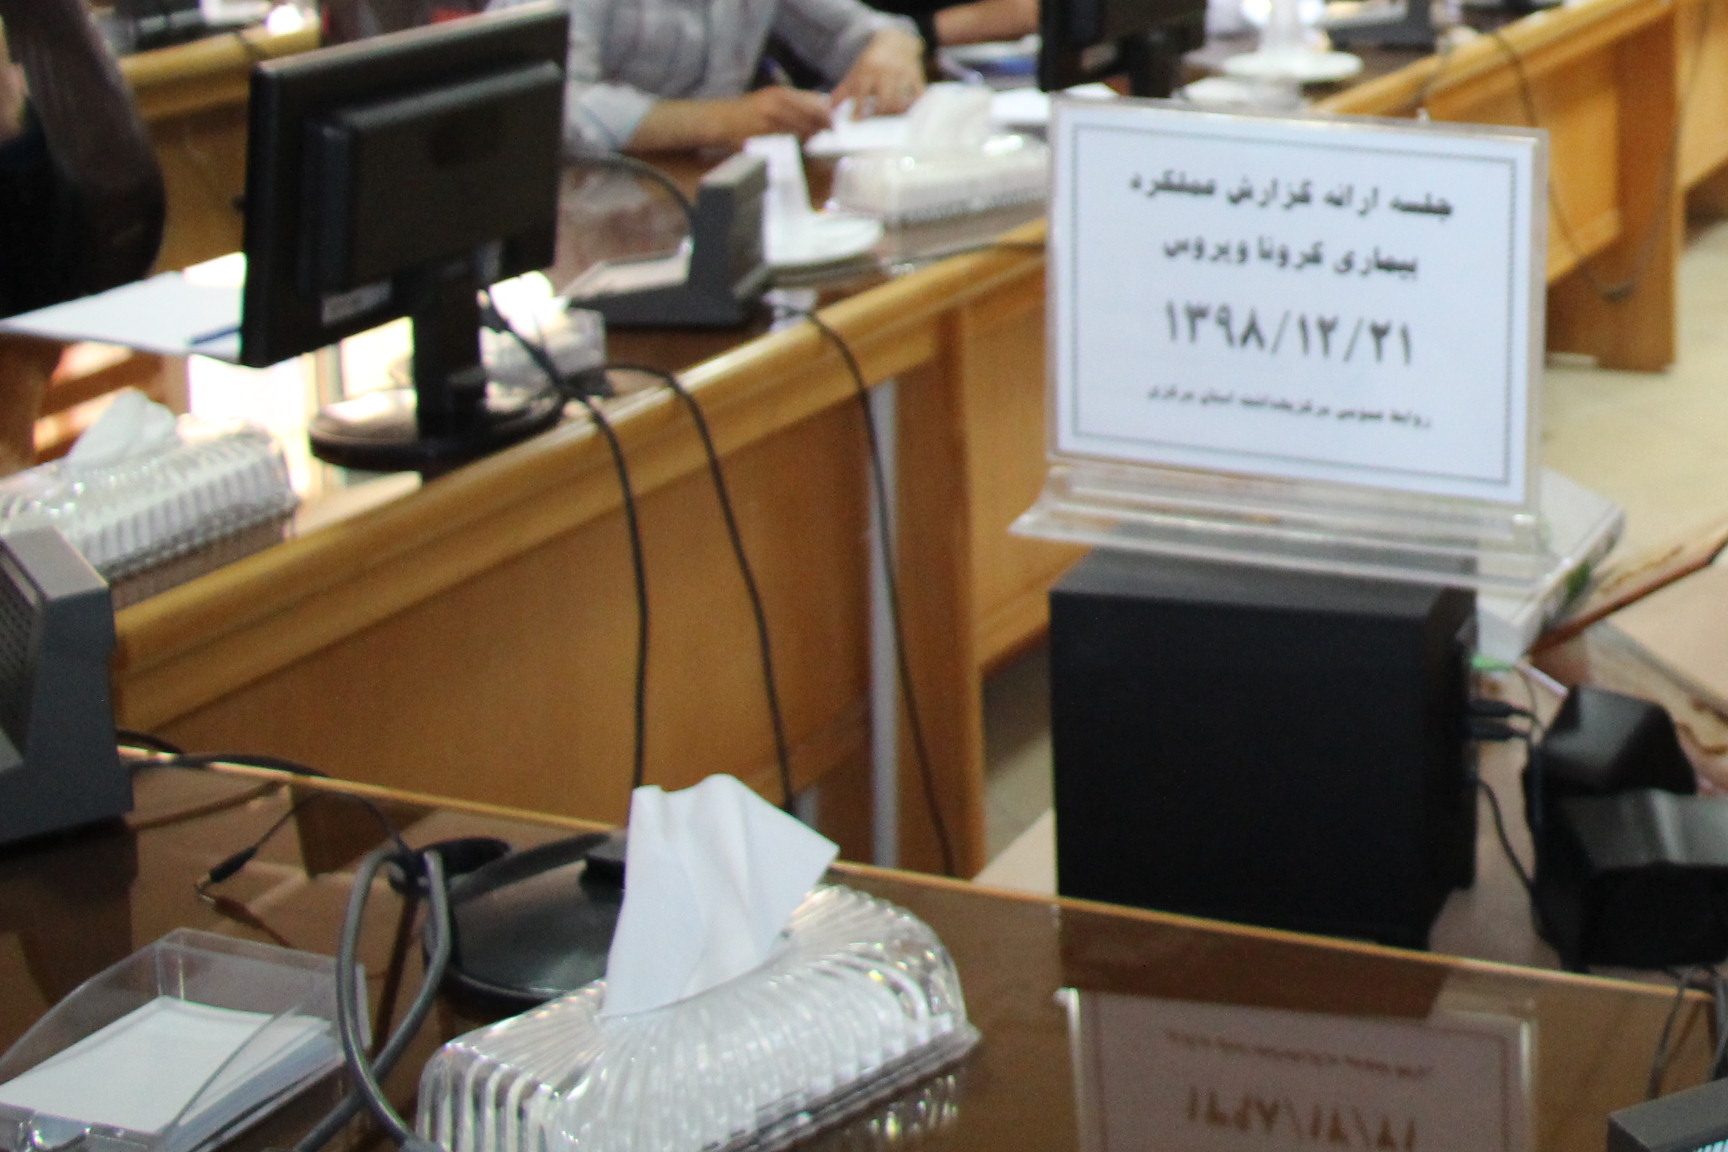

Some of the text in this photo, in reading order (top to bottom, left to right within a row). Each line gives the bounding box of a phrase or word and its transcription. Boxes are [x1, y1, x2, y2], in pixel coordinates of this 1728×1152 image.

[1391, 192, 1453, 223] جلسه
[1163, 235, 1247, 264] ویروس
[1257, 234, 1324, 268] کرونا
